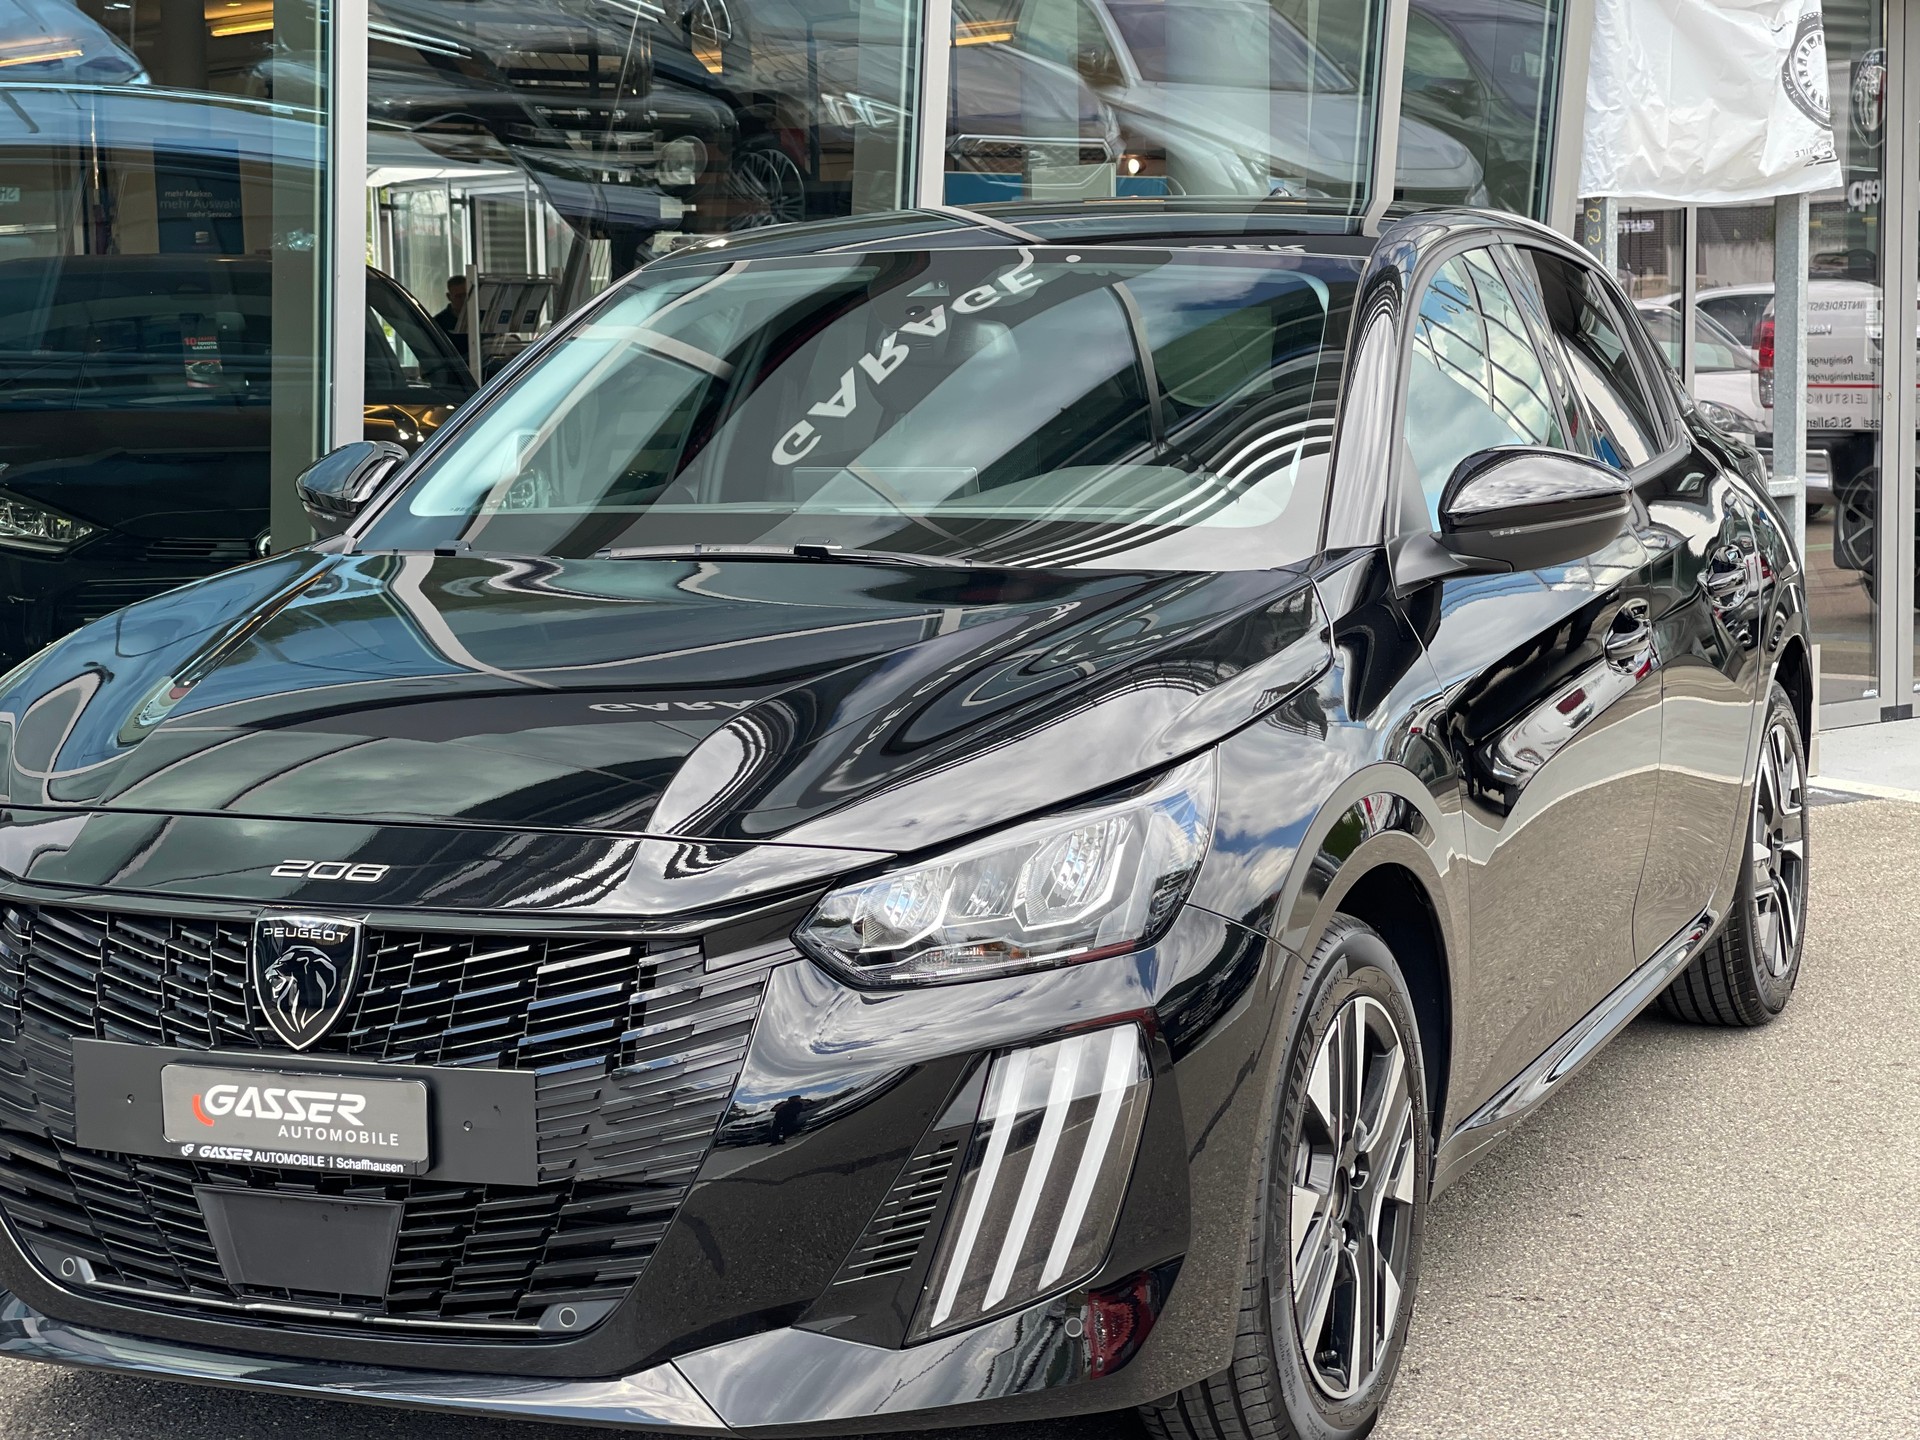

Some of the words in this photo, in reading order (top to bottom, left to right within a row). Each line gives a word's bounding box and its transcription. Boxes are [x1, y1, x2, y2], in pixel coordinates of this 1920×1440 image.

[160, 199, 192, 209] mehr
[193, 199, 241, 209] Auswahl
[183, 337, 197, 346] 10
[270, 859, 391, 883] 208
[263, 926, 349, 942] PEUGEOT
[204, 1084, 366, 1126] GASSER
[278, 1125, 399, 1147] AUTOMOBILE
[1274, 1027, 1315, 1227] MICHELIN
[199, 1145, 253, 1161] GASSER
[254, 1152, 325, 1167] AUTOMOBILE
[336, 1157, 404, 1173] Schaffhausen
